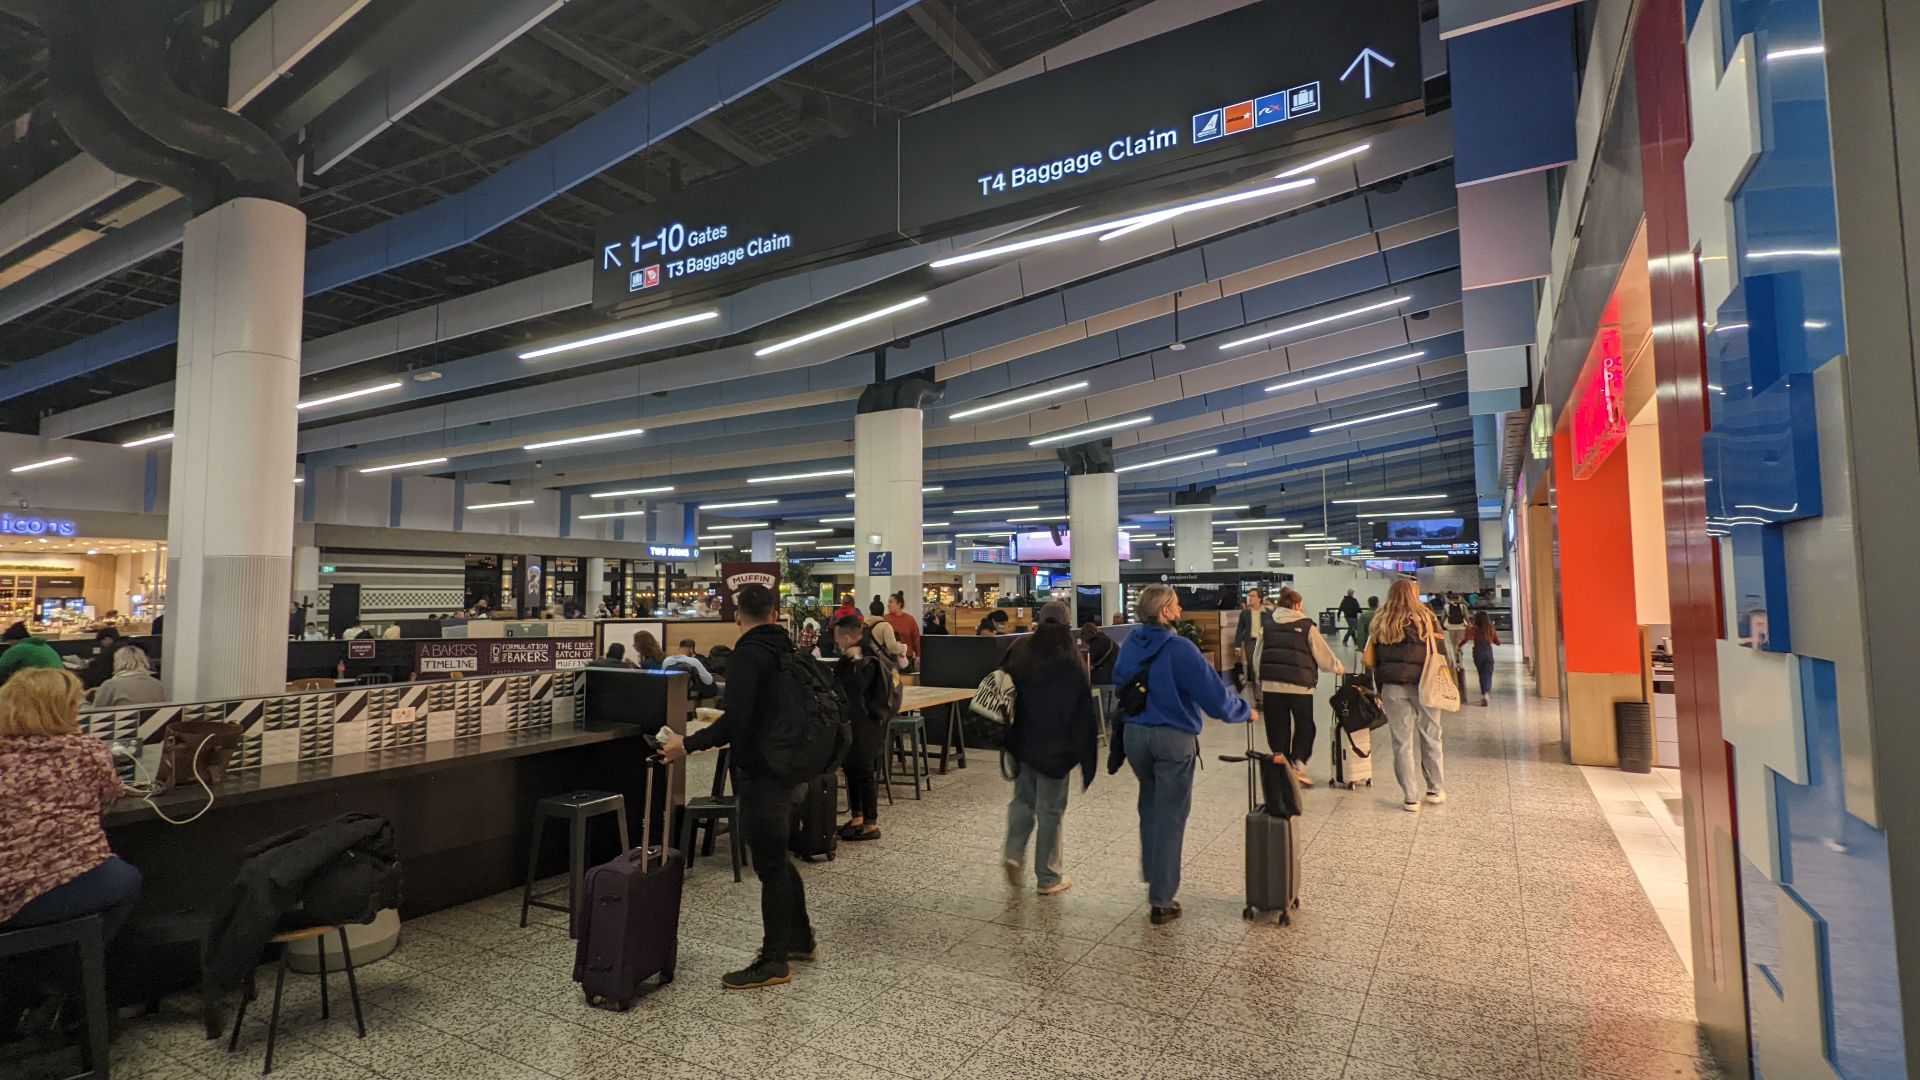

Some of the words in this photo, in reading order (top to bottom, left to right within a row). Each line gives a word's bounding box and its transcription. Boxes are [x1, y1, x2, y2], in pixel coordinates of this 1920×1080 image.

[977, 173, 1007, 196] T4
[1011, 150, 1103, 188] Baggage
[1107, 128, 1178, 161] Claim
[687, 224, 728, 248] Gates
[666, 261, 684, 279] T3
[686, 243, 745, 274] Baggage
[747, 232, 791, 257] Claim
[1, 513, 75, 535] icons
[732, 574, 770, 585] MUFFIN
[420, 645, 431, 657] A
[432, 643, 478, 657] BAKER'S
[502, 643, 548, 651] FORMULATION
[555, 642, 573, 650] THE
[507, 652, 549, 663] BAKERS
[555, 650, 581, 658] BATCH
[582, 650, 593, 658] OF
[423, 659, 475, 669] TIMELINE
